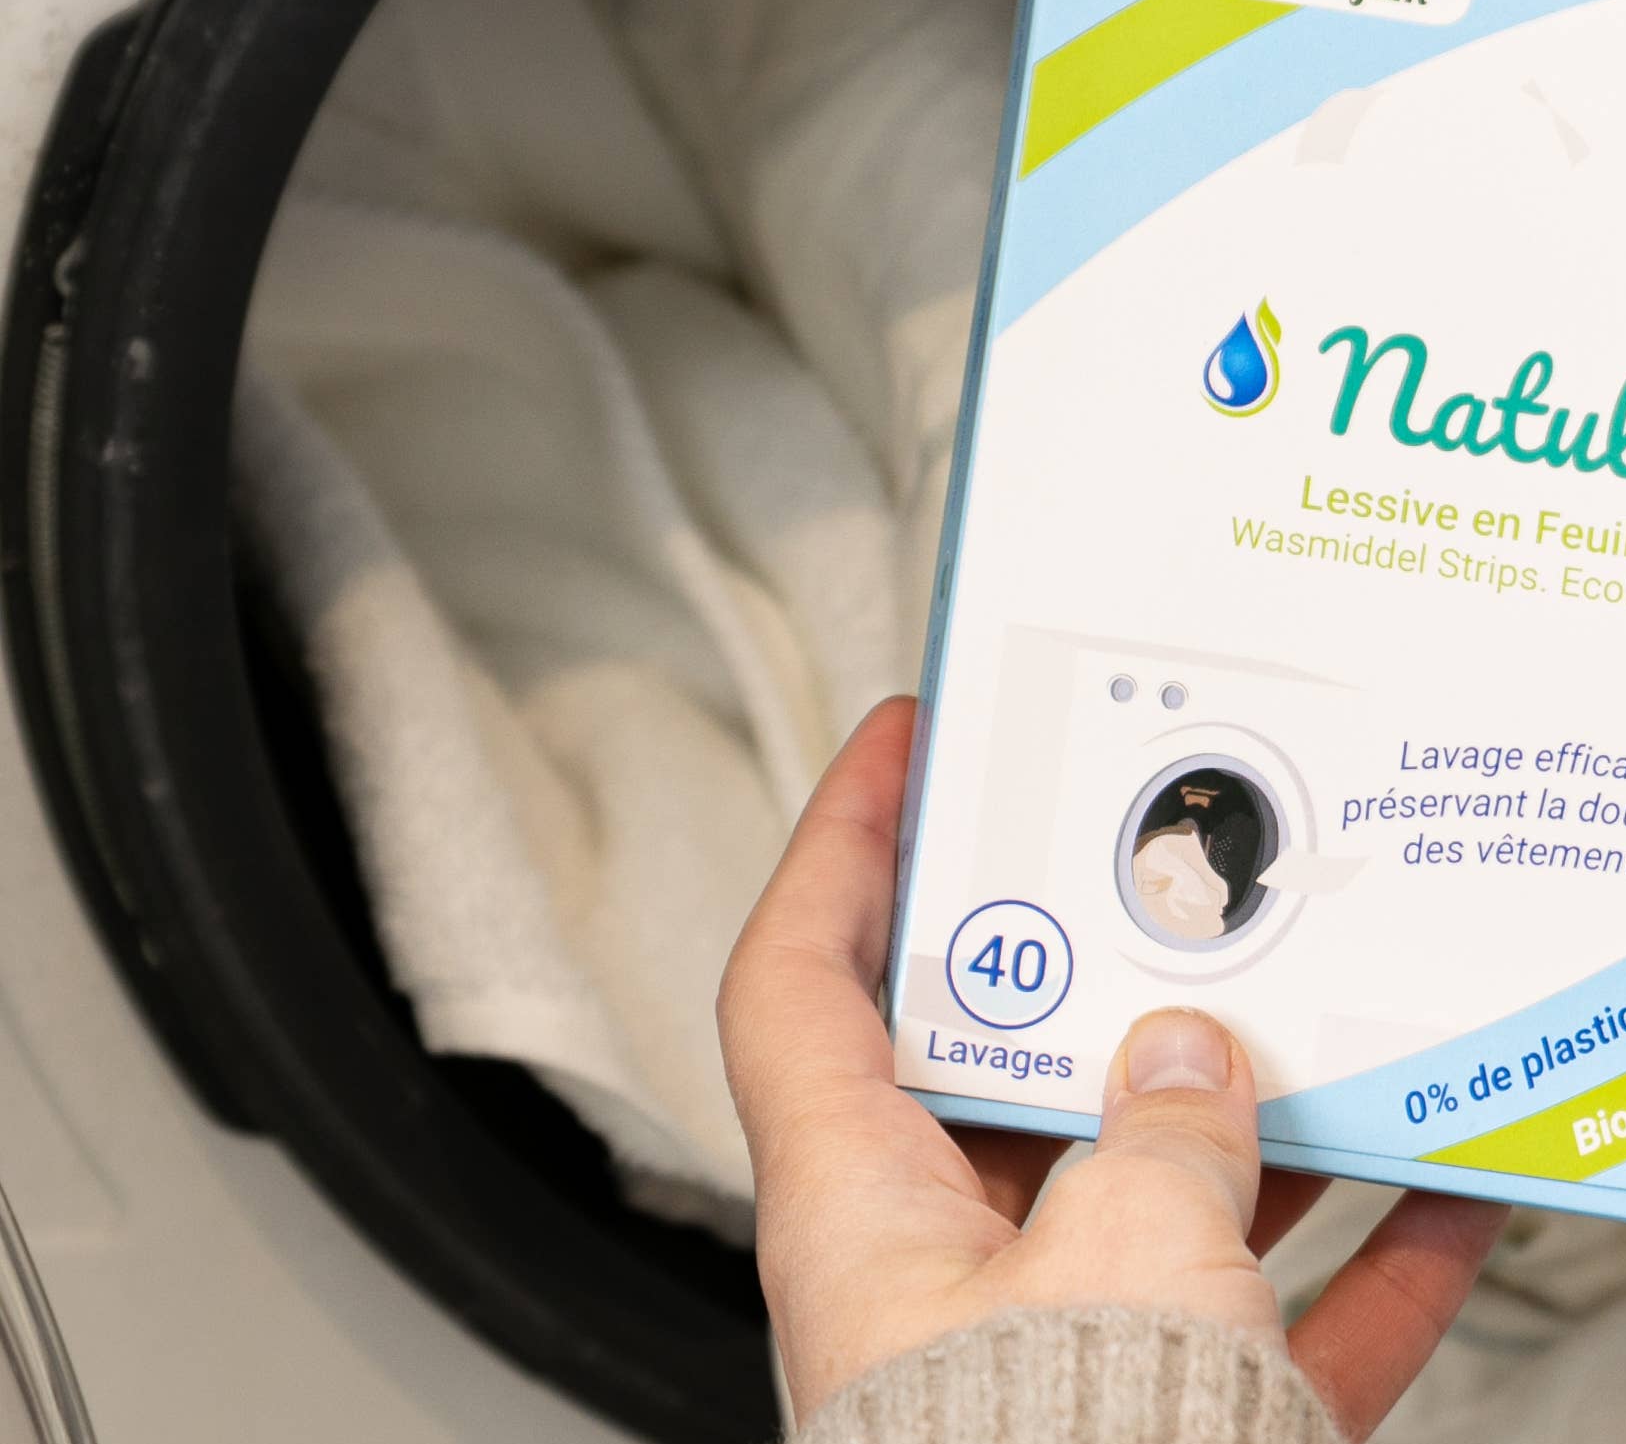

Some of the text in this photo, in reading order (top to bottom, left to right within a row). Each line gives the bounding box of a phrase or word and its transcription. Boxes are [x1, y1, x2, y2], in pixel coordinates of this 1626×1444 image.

[1301, 475, 1458, 531] Lessive
[1473, 508, 1520, 541] en
[1231, 516, 1427, 575] Wasmiddel
[1438, 548, 1546, 594] Strips.
[1400, 741, 1523, 777] Lavage
[1342, 787, 1528, 831] préservant
[1537, 788, 1566, 820] la
[1403, 833, 1464, 865] des
[968, 935, 1047, 993] 40
[927, 1030, 1074, 1080] Lavages
[1404, 1083, 1458, 1124] 0%
[1468, 1062, 1512, 1102] de
